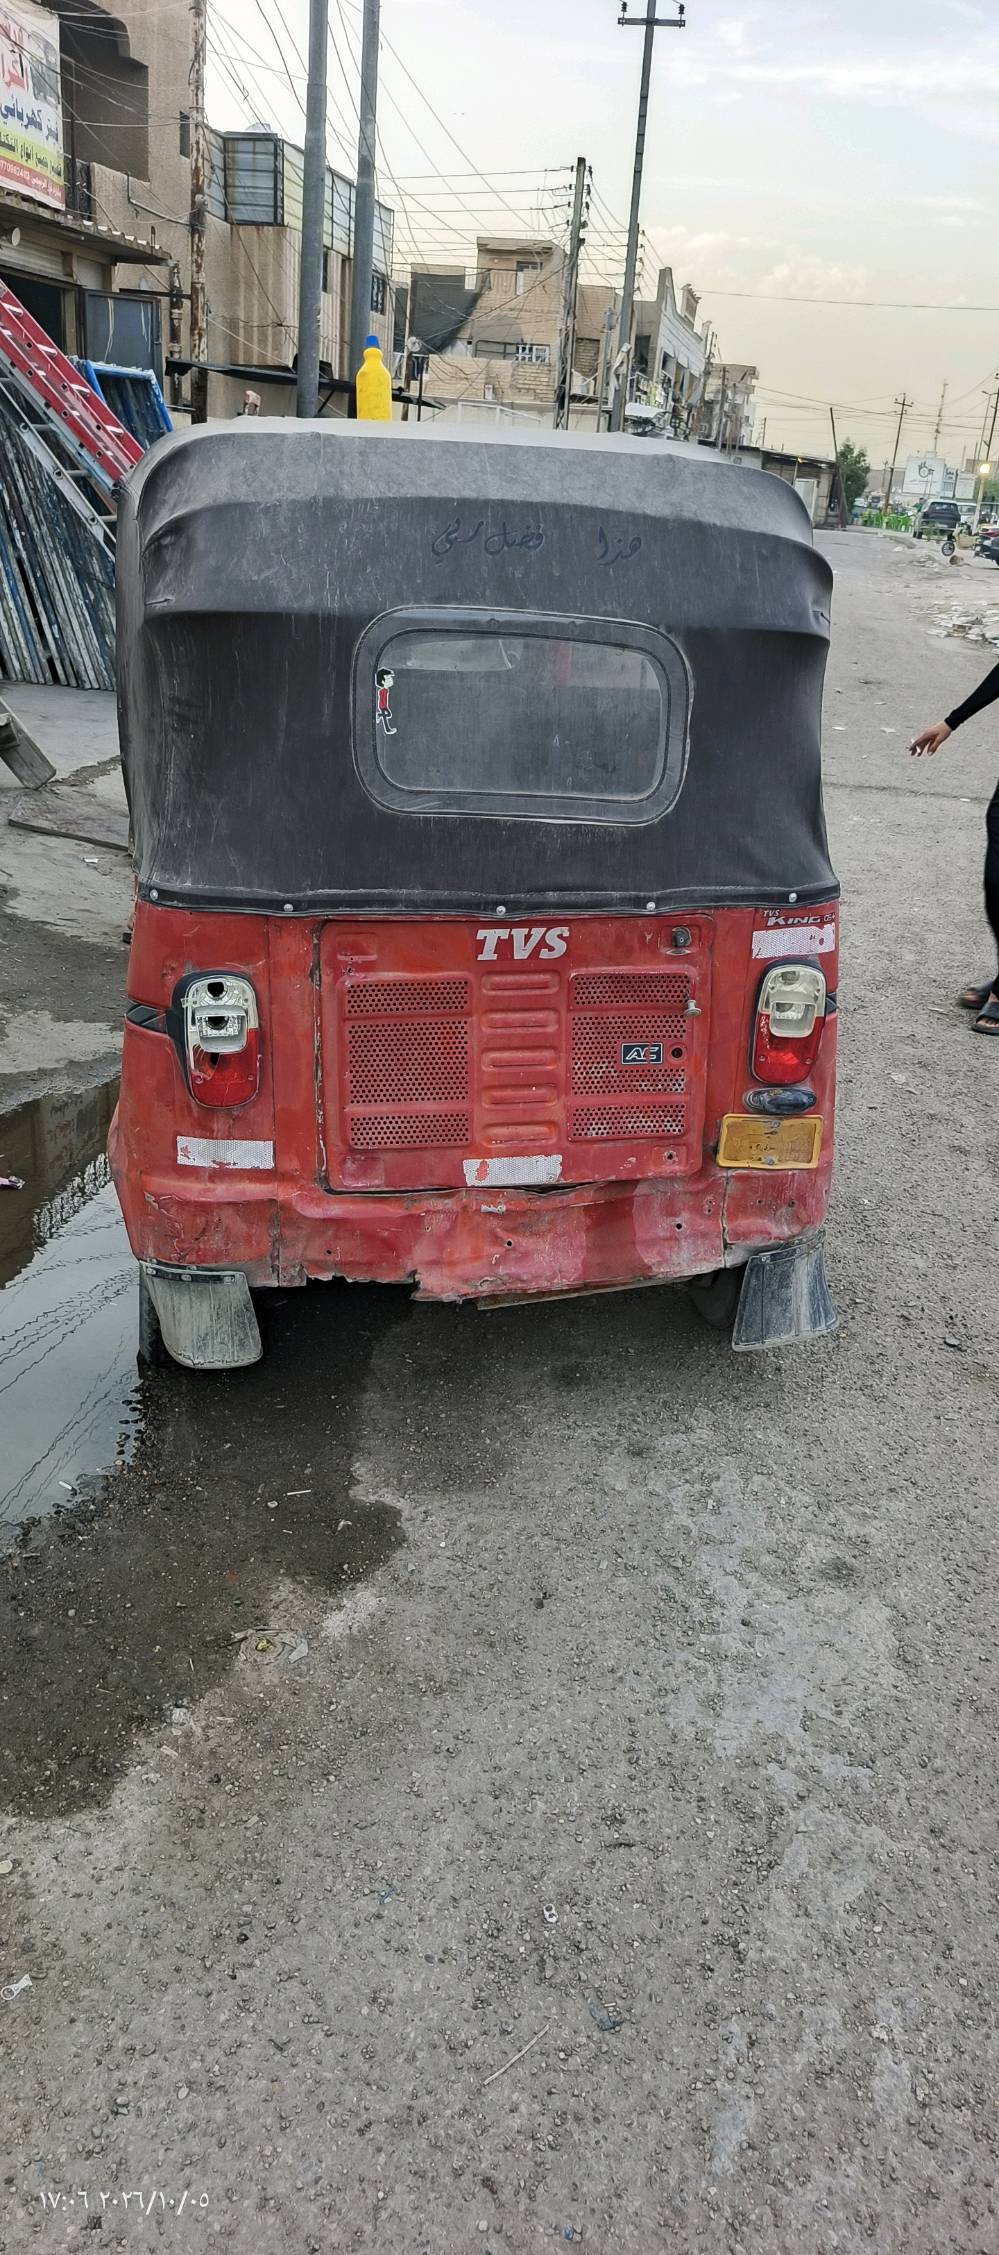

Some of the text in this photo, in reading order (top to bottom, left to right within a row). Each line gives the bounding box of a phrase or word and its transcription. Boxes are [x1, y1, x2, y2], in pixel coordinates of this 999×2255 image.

[0, 96, 43, 131] كهربائي
[485, 521, 545, 556] فضل
[763, 909, 781, 918] TVS
[766, 915, 822, 928] KING
[476, 926, 570, 961] TVS
